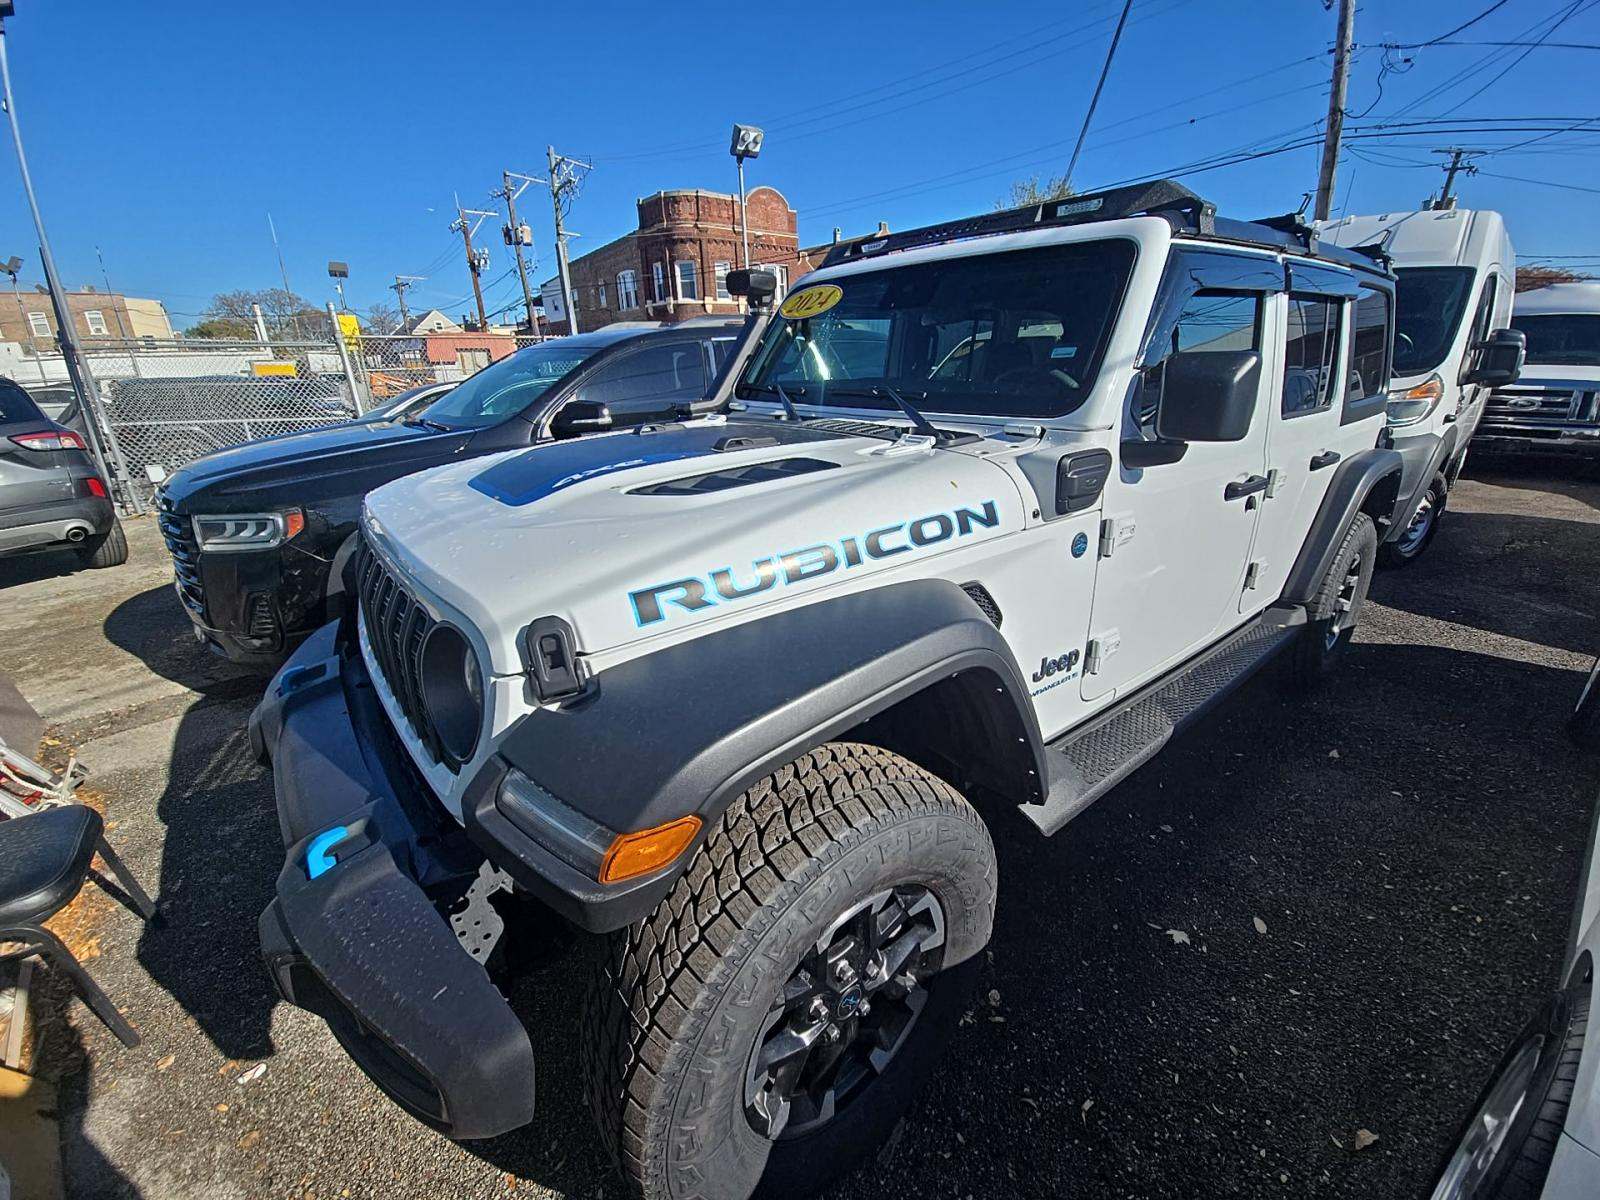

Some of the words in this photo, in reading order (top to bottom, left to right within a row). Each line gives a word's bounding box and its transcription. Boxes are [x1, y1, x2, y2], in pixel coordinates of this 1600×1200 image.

[785, 290, 837, 313] 2024
[628, 500, 1000, 627] RUBICON
[1032, 649, 1080, 682] Jeep
